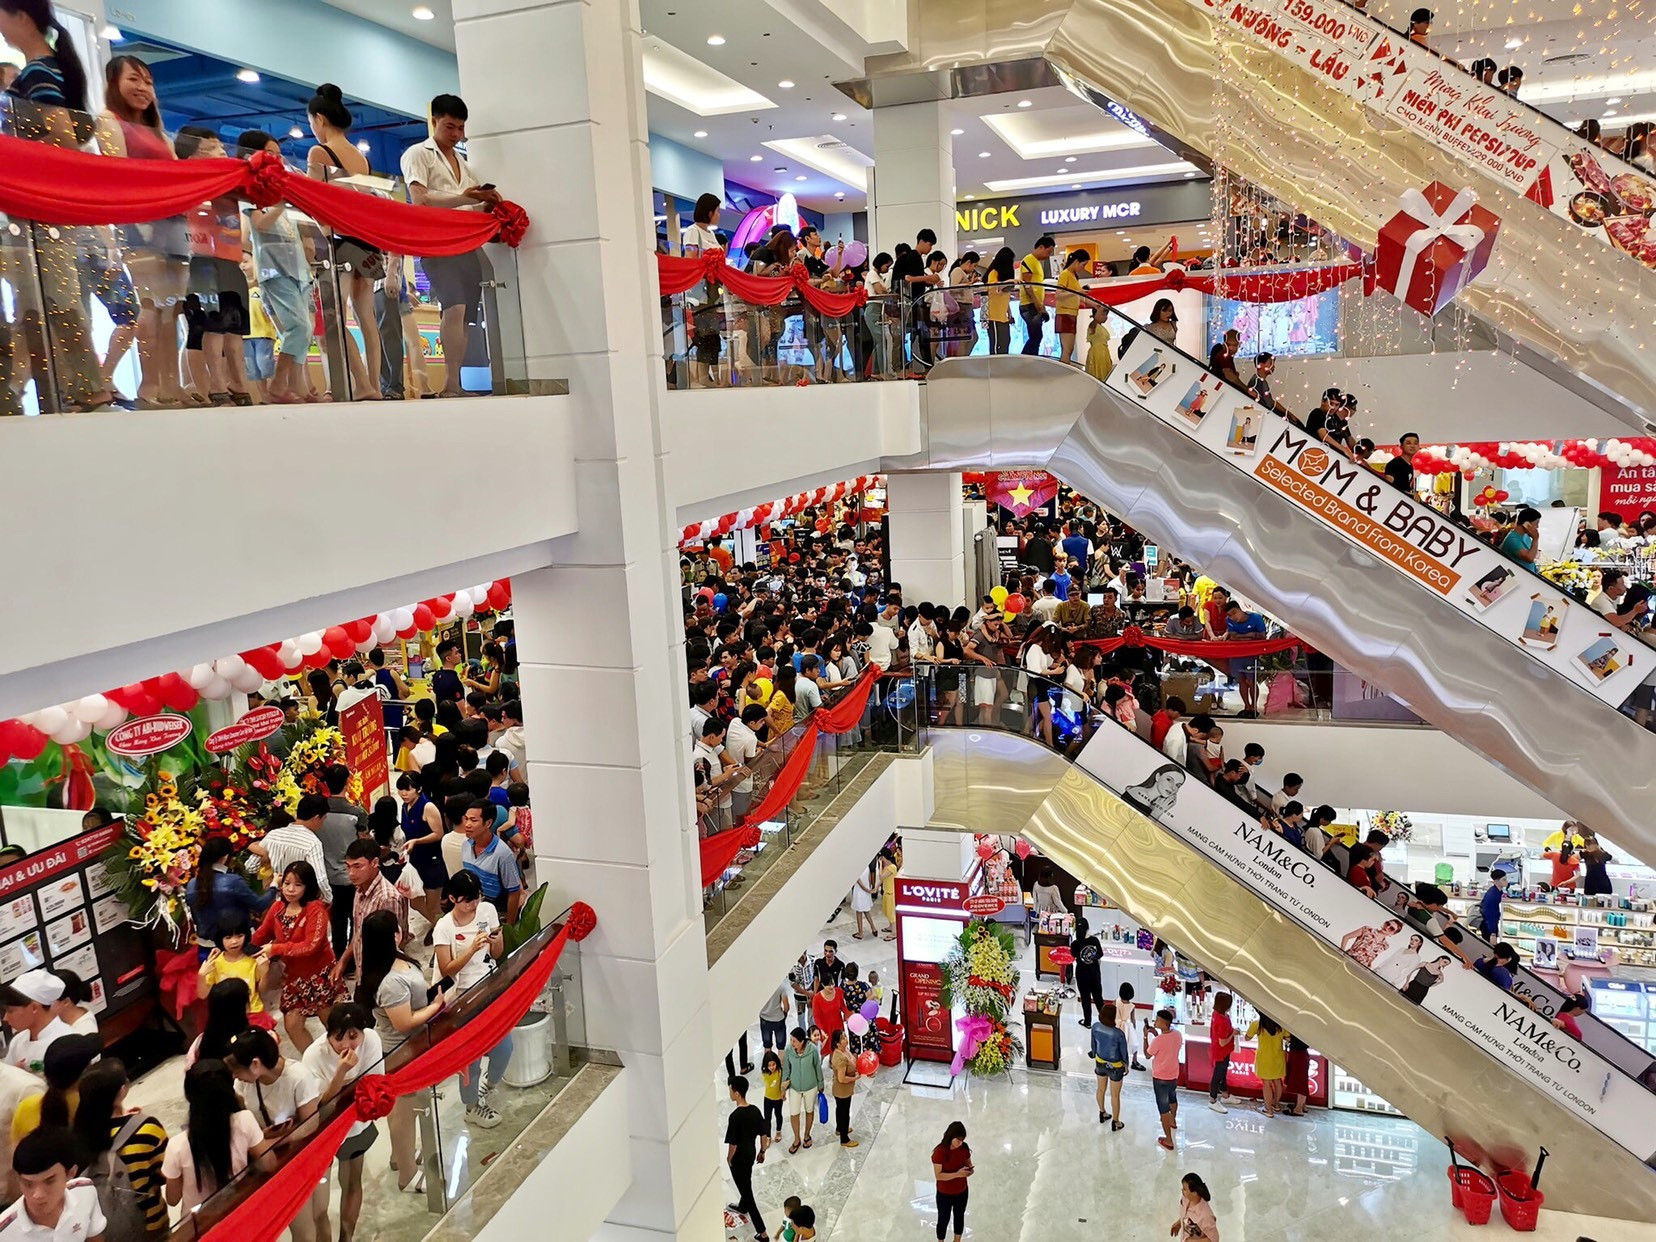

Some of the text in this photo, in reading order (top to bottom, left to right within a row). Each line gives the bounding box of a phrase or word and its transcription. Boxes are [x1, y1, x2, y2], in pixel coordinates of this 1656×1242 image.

[1283, 0, 1345, 40] 159.000
[1230, 3, 1293, 48] NƯỚNG
[1309, 48, 1350, 81] LẨU
[1463, 91, 1499, 121] Khai
[1396, 105, 1418, 122] CHO
[1416, 117, 1443, 136] MENU
[1504, 169, 1525, 183] VNĐ
[1402, 88, 1537, 172] MIỄN PHÍ PEPSI/7UP
[955, 204, 1021, 231] NICK
[1041, 202, 1141, 225] LUXURY MCR
[1610, 483, 1641, 493] mua
[1641, 466, 1656, 478] tâ
[1269, 426, 1481, 569] MOM & BABY
[1261, 460, 1451, 588] Selected Brand From Korea
[0, 852, 67, 889] ẠI & ƯU ĐÃI
[1187, 826, 1331, 929] MANG CẢM HỨNG THỜI TRANG TỪ LONDON
[1252, 855, 1283, 880] London
[902, 885, 960, 900] L'OVITÉ
[1441, 1004, 1597, 1115] MANG CẢM HỨNG THỜI TRANG TỪ LONDON
[1512, 1037, 1546, 1063] London
